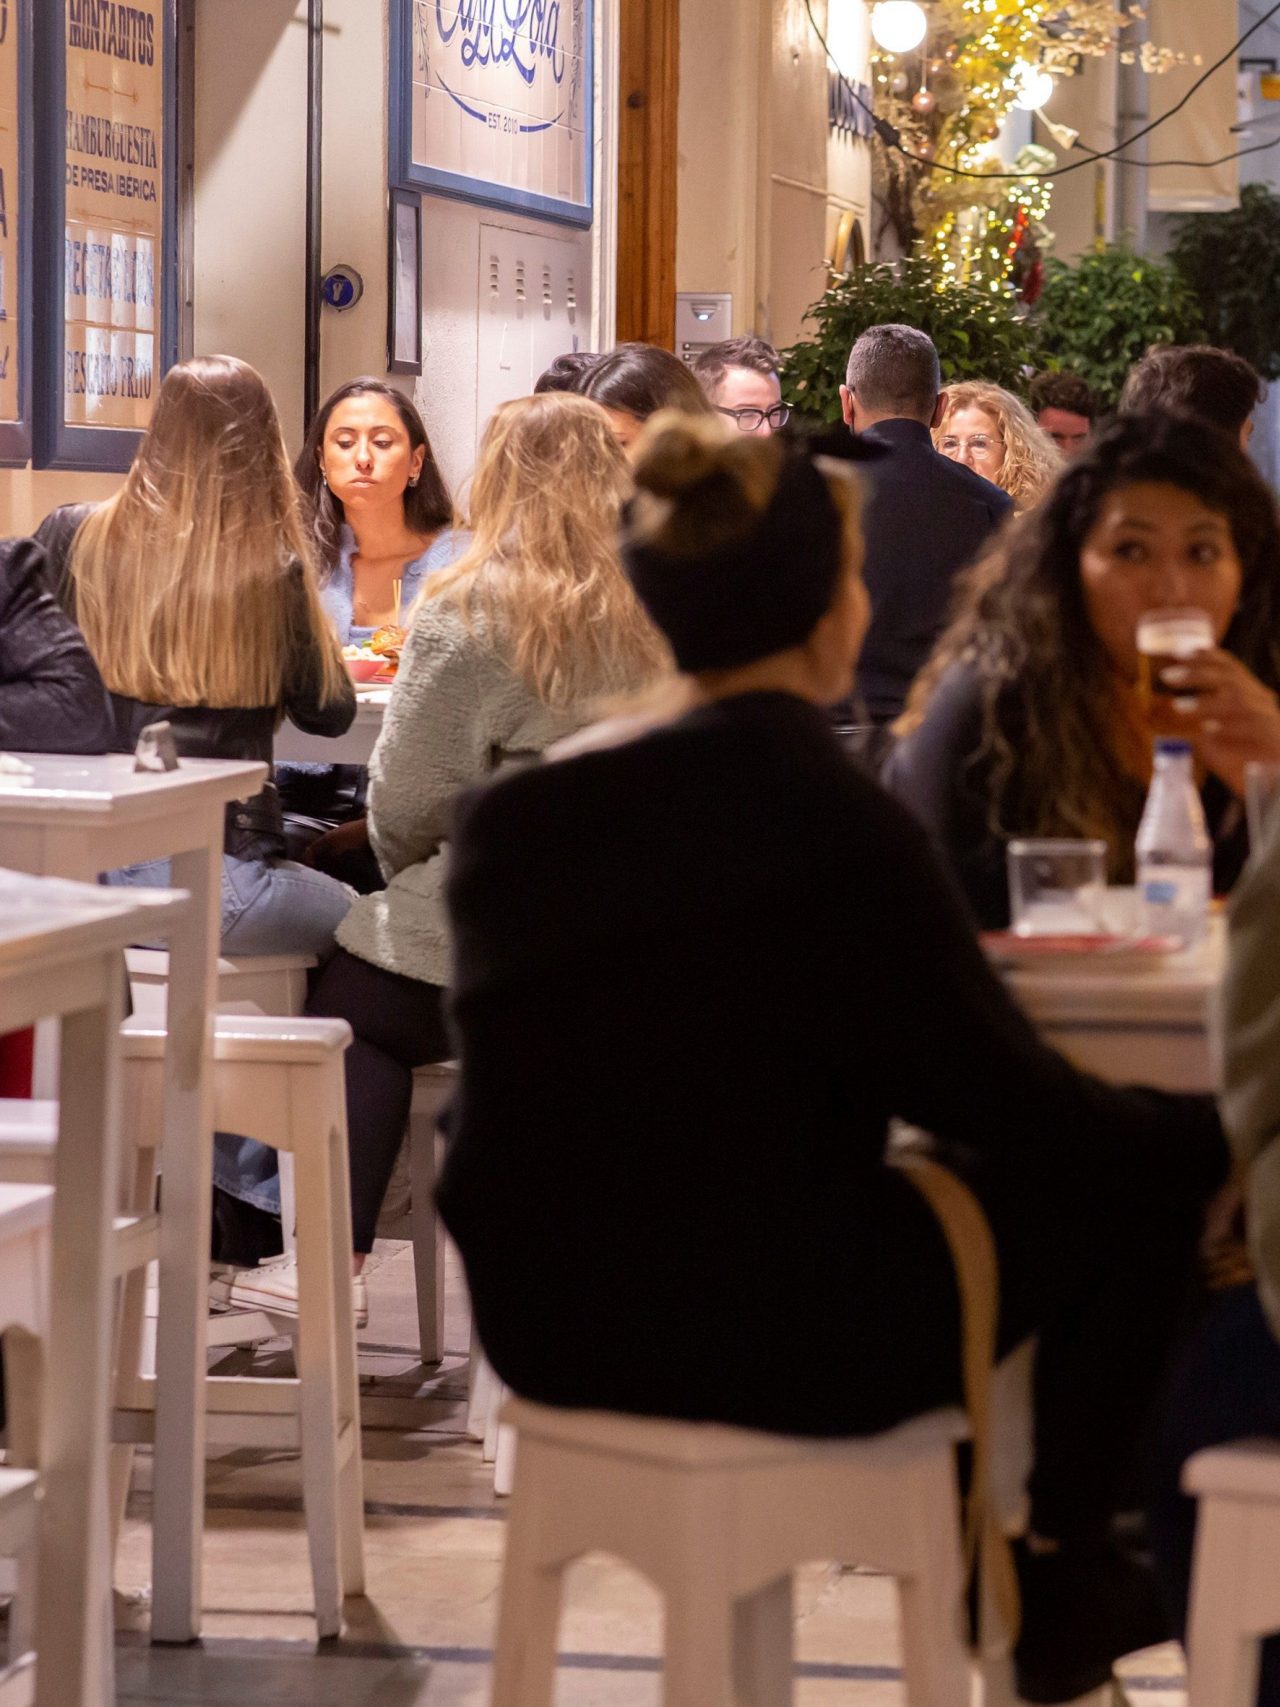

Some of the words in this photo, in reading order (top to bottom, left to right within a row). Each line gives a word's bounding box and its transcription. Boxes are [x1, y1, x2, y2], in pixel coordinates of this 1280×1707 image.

[69, 0, 154, 66] MONTADITOS
[81, 166, 115, 193] PRESA
[116, 170, 157, 202] IBÉRICA
